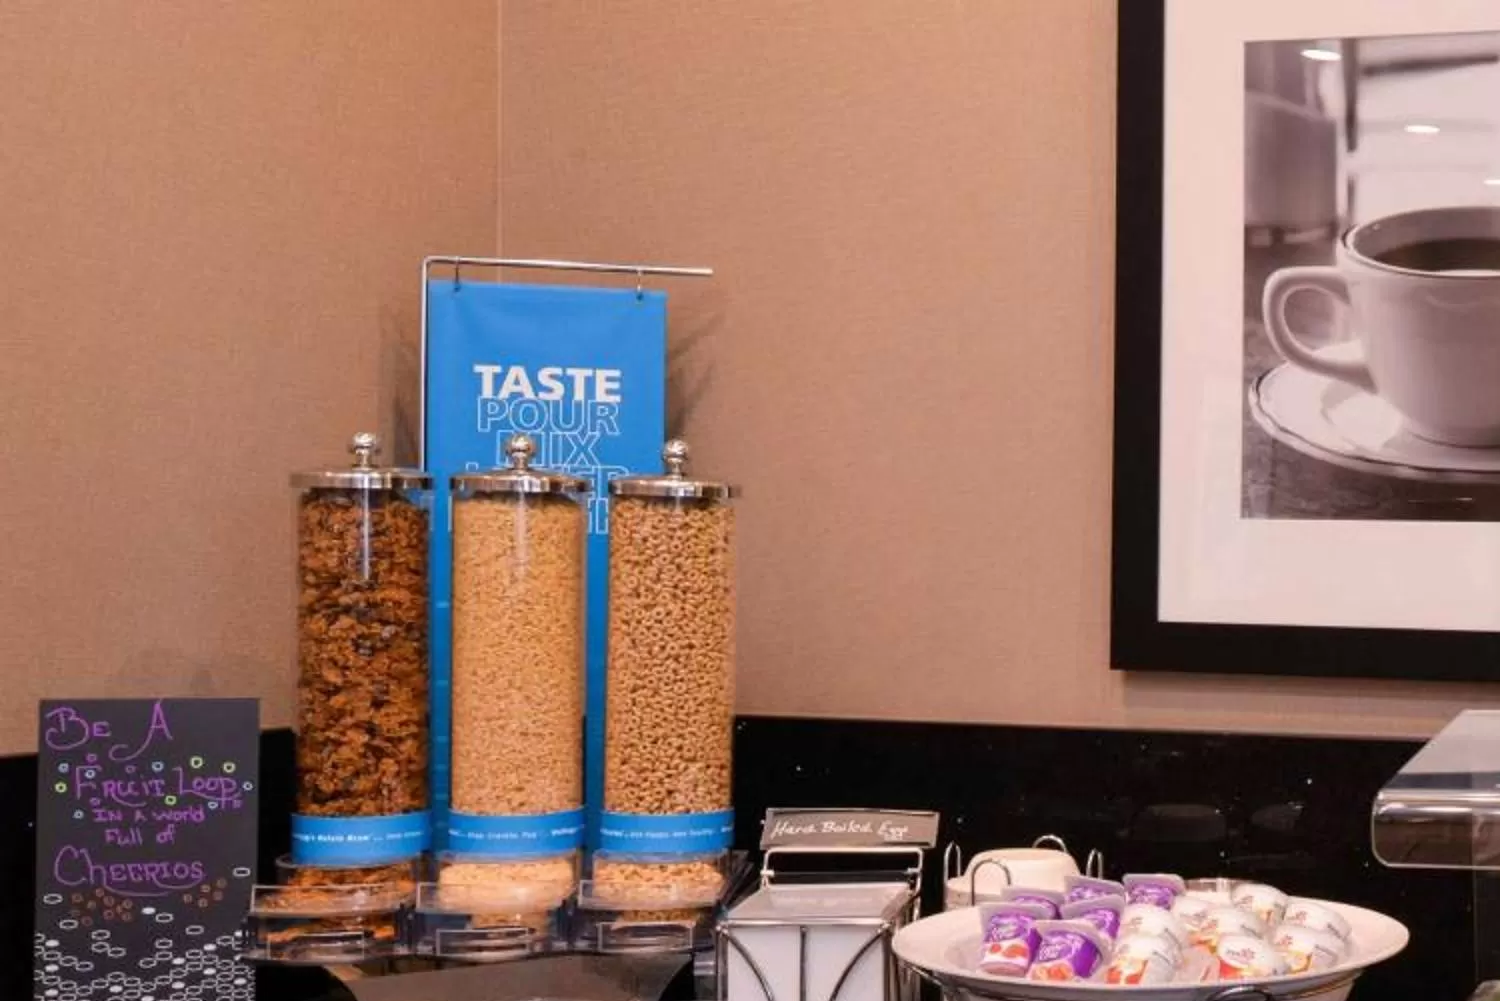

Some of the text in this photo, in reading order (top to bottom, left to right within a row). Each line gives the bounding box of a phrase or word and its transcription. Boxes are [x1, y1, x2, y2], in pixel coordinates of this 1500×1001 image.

[473, 364, 622, 402] TASTE
[477, 397, 620, 435] POUR
[109, 699, 173, 761] A
